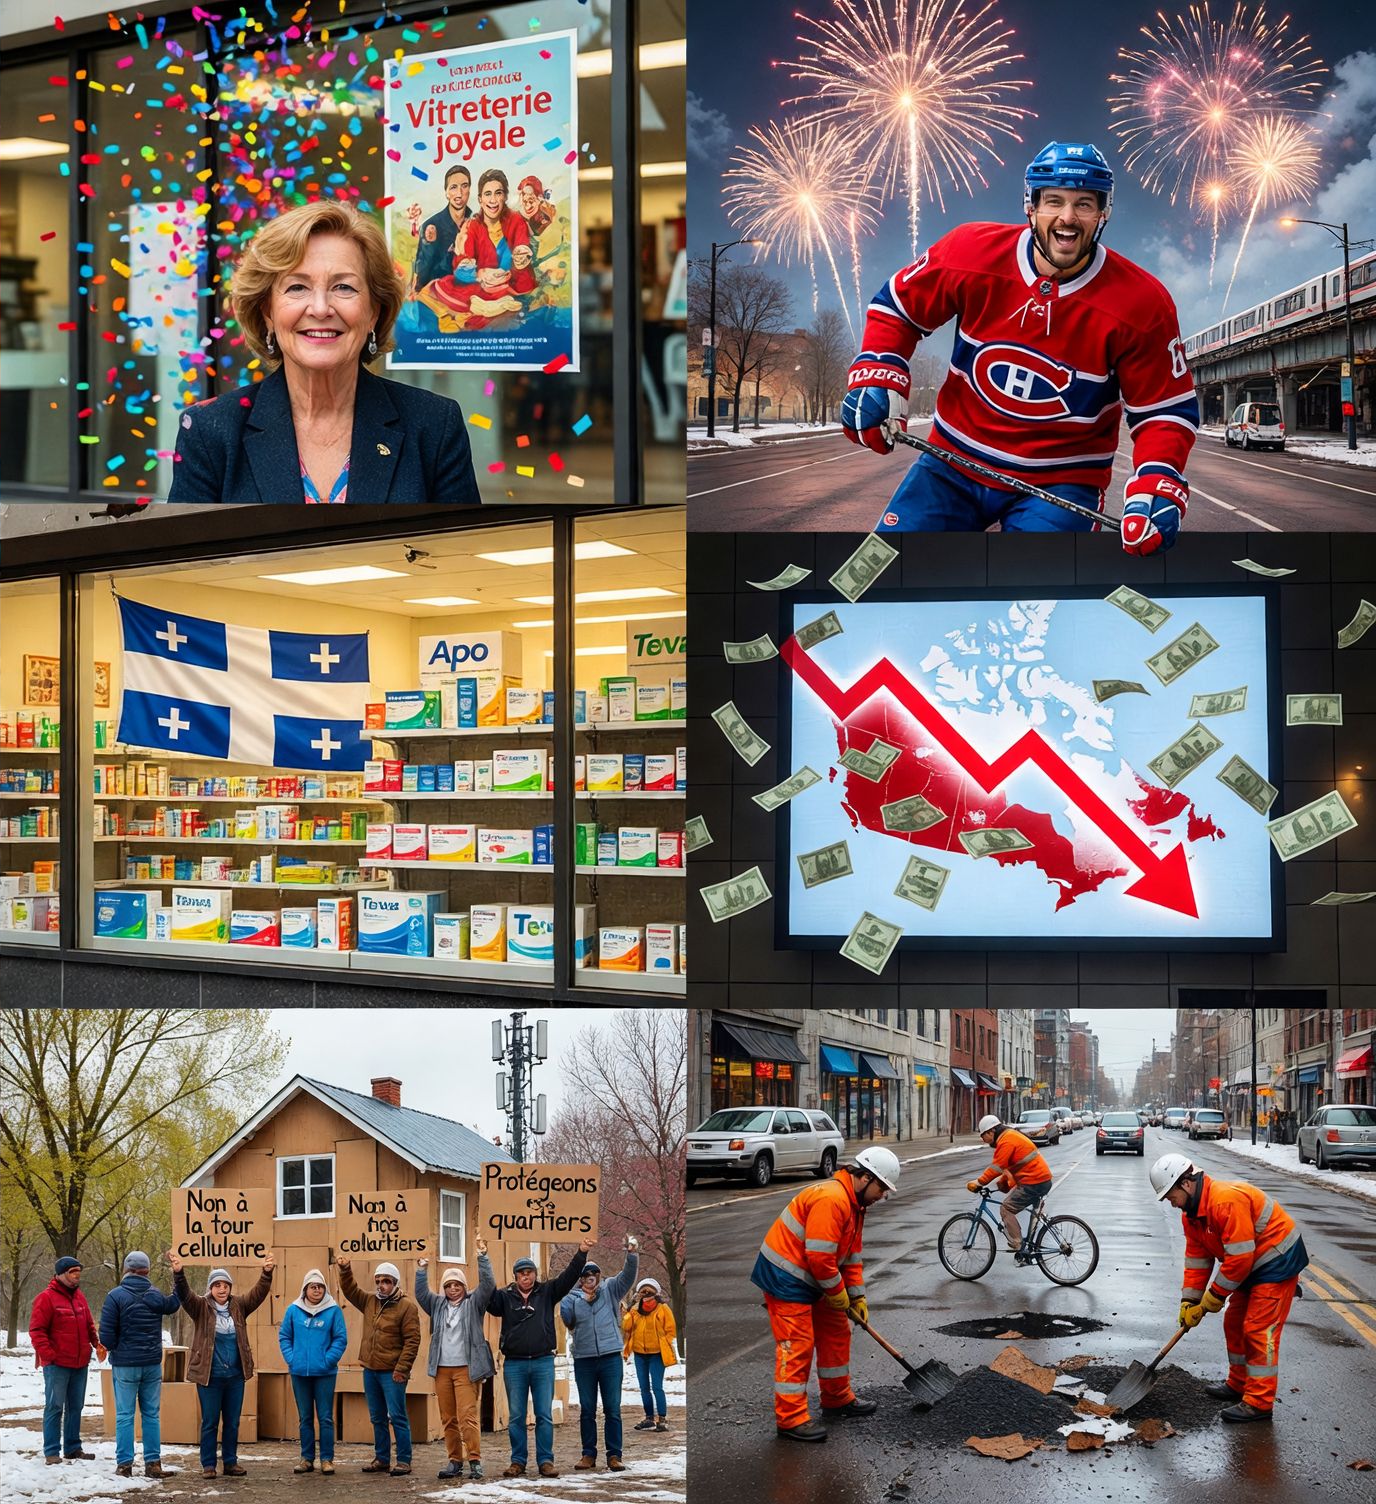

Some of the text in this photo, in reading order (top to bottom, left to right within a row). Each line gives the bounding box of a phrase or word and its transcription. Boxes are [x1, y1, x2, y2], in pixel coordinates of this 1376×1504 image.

[405, 85, 552, 128] Vitreterie
[433, 120, 526, 165] joyale
[428, 640, 489, 673] Apo
[485, 1164, 597, 1201] Protégeons
[187, 1189, 249, 1212] Non à
[395, 1193, 408, 1213] à
[186, 1213, 254, 1235] la tour
[489, 1209, 592, 1240] quartiers
[177, 1235, 266, 1259] cellulaire
